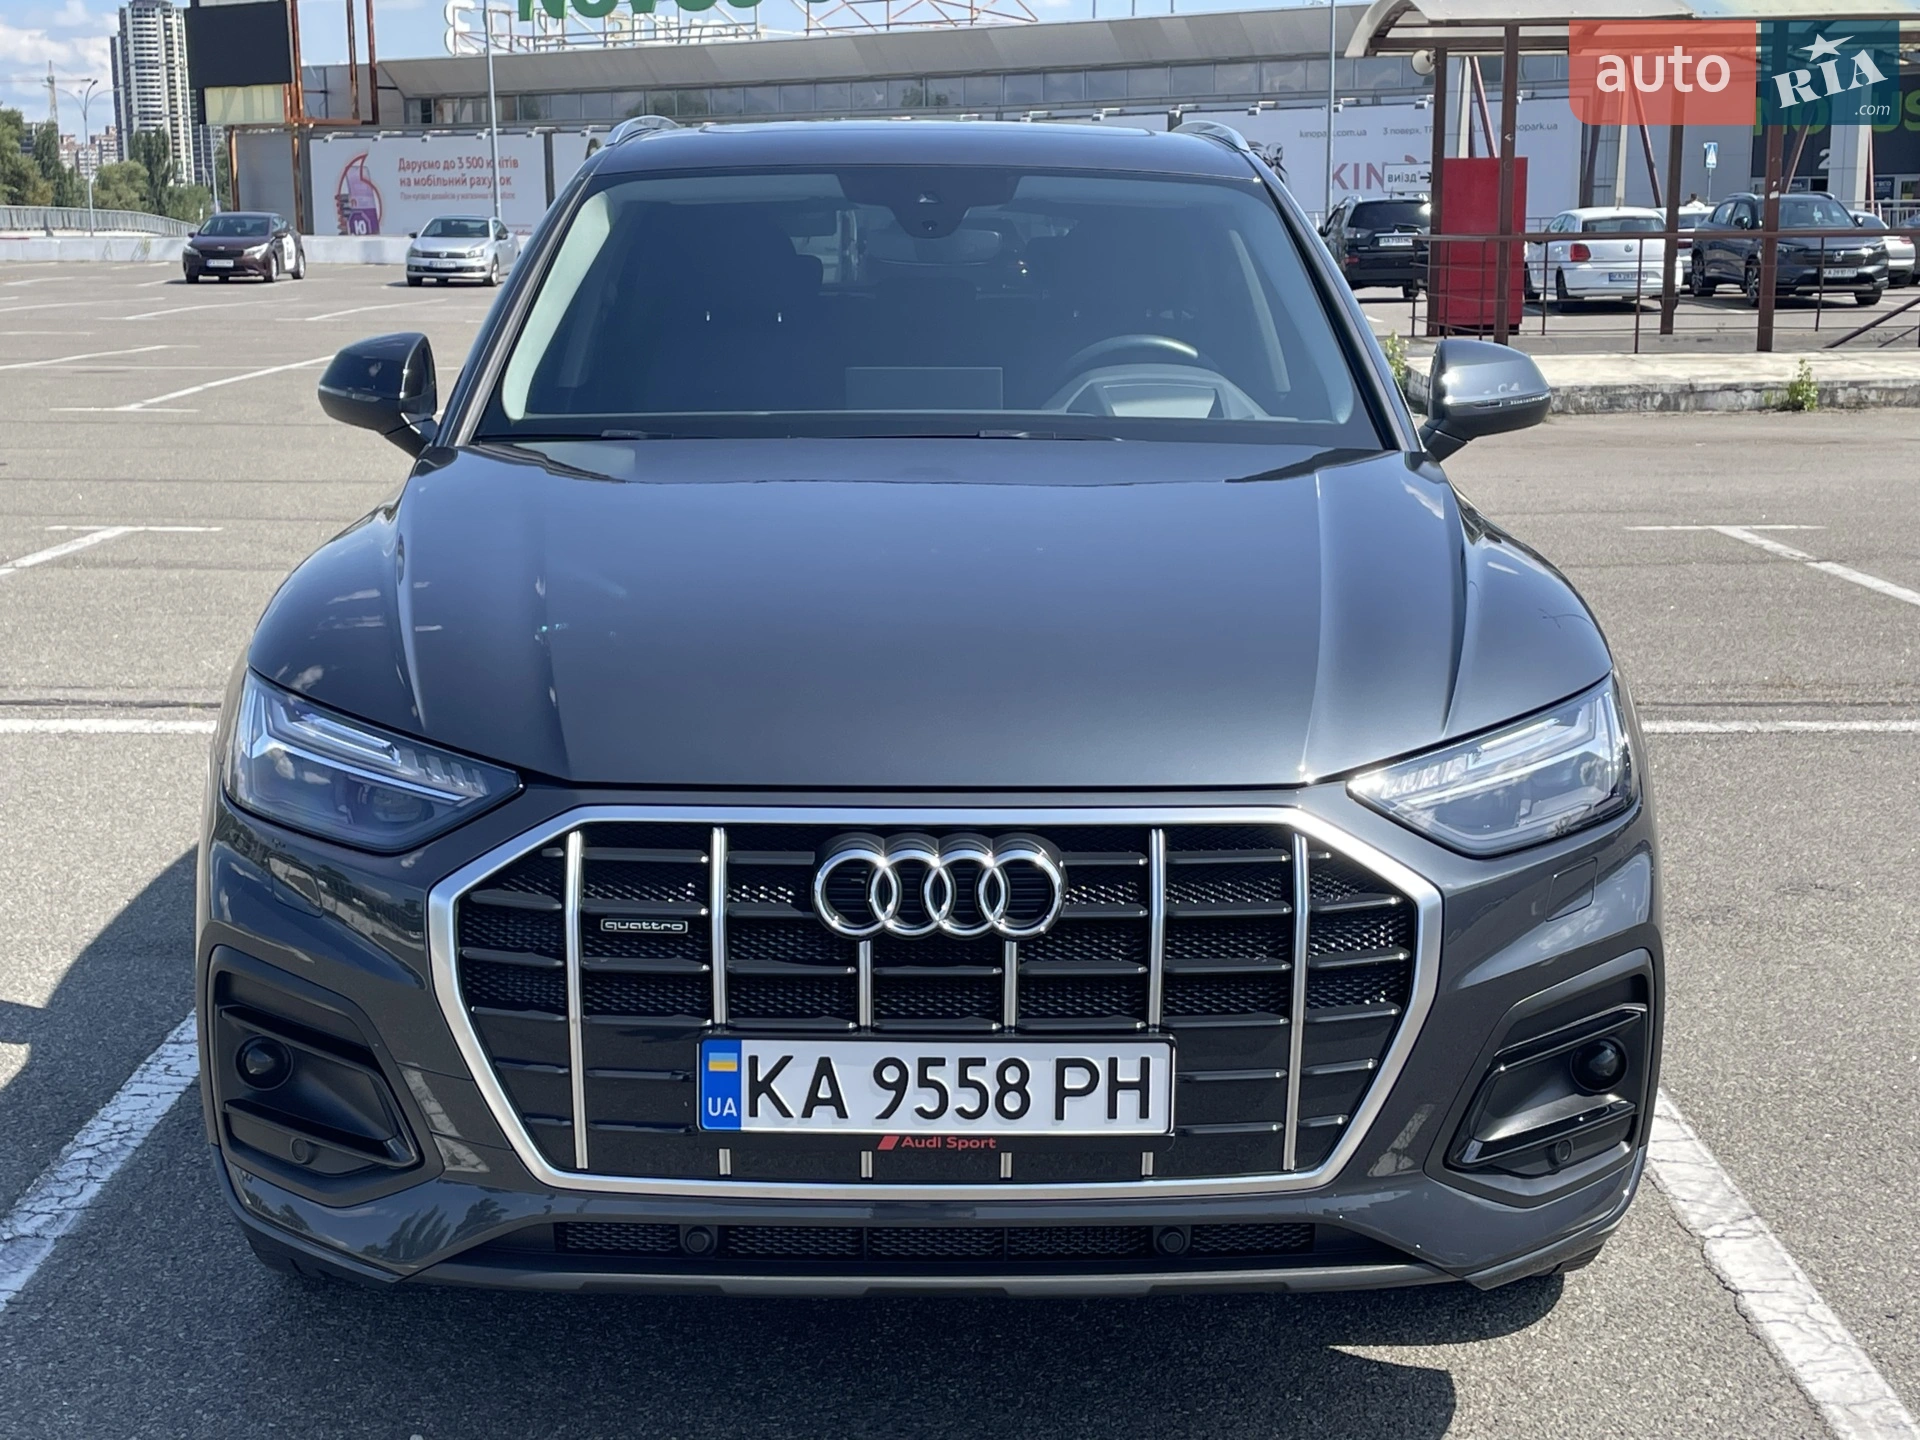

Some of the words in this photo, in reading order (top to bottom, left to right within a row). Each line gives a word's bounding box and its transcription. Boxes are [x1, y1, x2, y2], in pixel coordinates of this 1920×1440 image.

[1752, 89, 1920, 136] NOUS
[1299, 129, 1367, 138] kinopa.com.ua
[1383, 127, 1388, 136] 3
[398, 157, 441, 173] Даруємо
[443, 160, 456, 171] до
[457, 156, 464, 169] 3
[465, 157, 484, 169] 500
[486, 155, 519, 169] юітів
[400, 178, 411, 187] на
[414, 173, 467, 187] мобільний
[470, 175, 512, 189] рахуок
[604, 921, 684, 932] quattro
[747, 1055, 849, 1119] KA
[873, 1056, 1031, 1120] 9558
[1055, 1056, 1151, 1121] PH
[708, 1096, 738, 1118] UA
[901, 1136, 942, 1148] Audi
[946, 1136, 997, 1151] Sport
